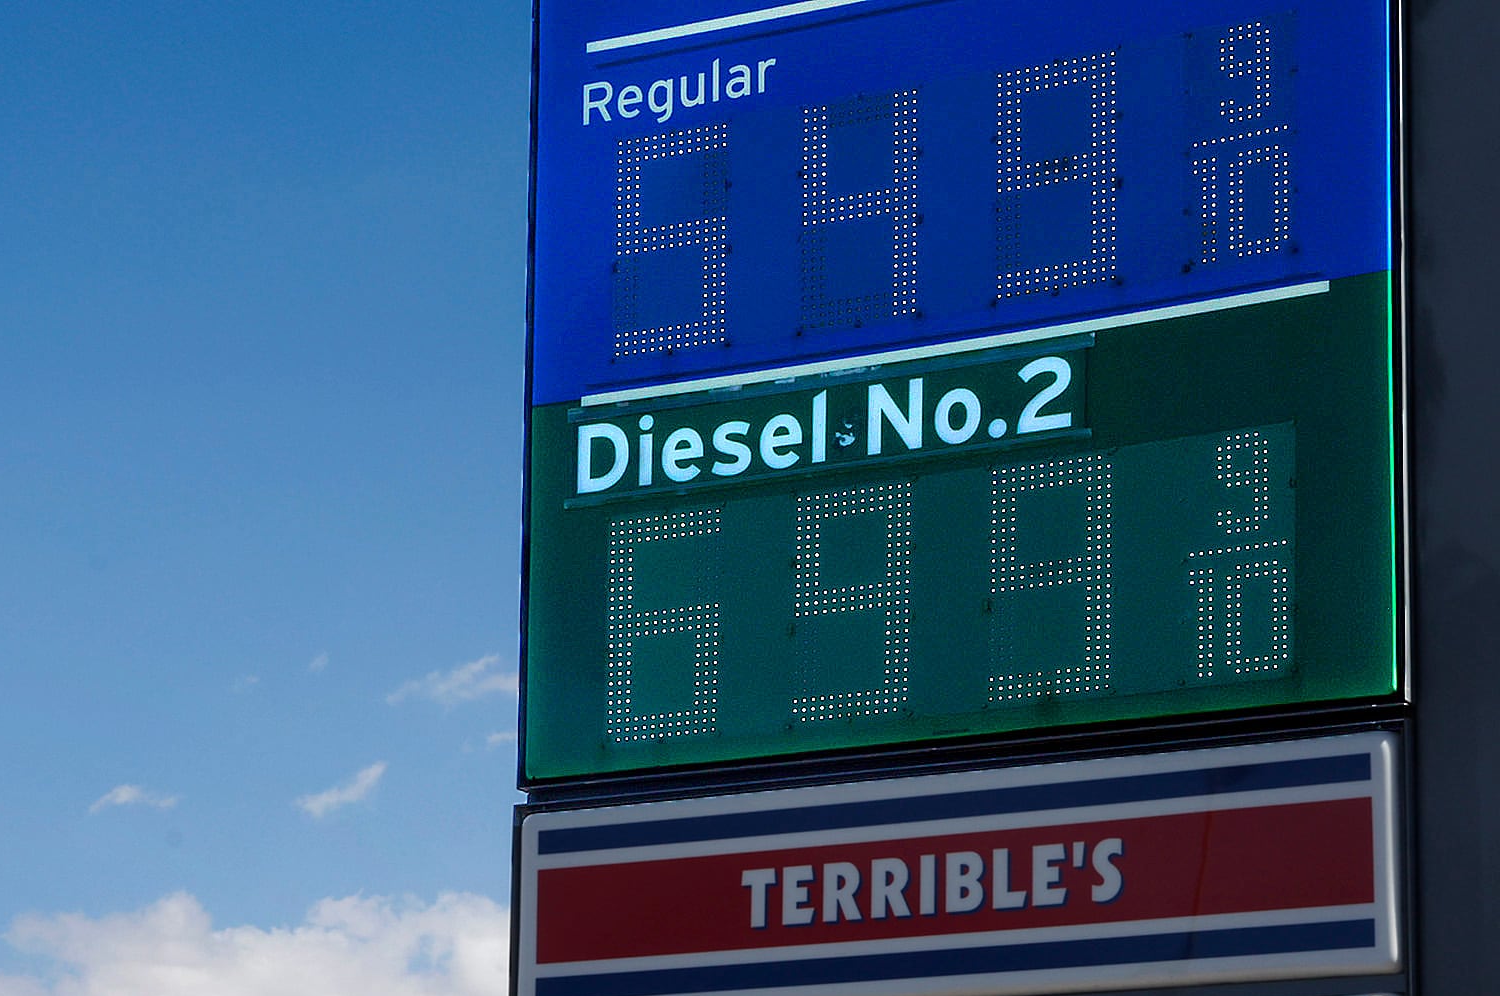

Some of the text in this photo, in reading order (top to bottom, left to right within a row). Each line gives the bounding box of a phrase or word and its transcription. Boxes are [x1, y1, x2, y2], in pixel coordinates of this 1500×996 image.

[582, 56, 777, 126] Regular
[1218, 20, 1273, 124] 9
[614, 50, 1119, 359] 549
[1191, 143, 1291, 265] 10
[576, 356, 1074, 495] Diesel No.2
[1214, 430, 1271, 535] 9
[605, 453, 1114, 745] 699
[1188, 559, 1290, 679] 10
[741, 837, 1126, 930] TERRIBLE'S
